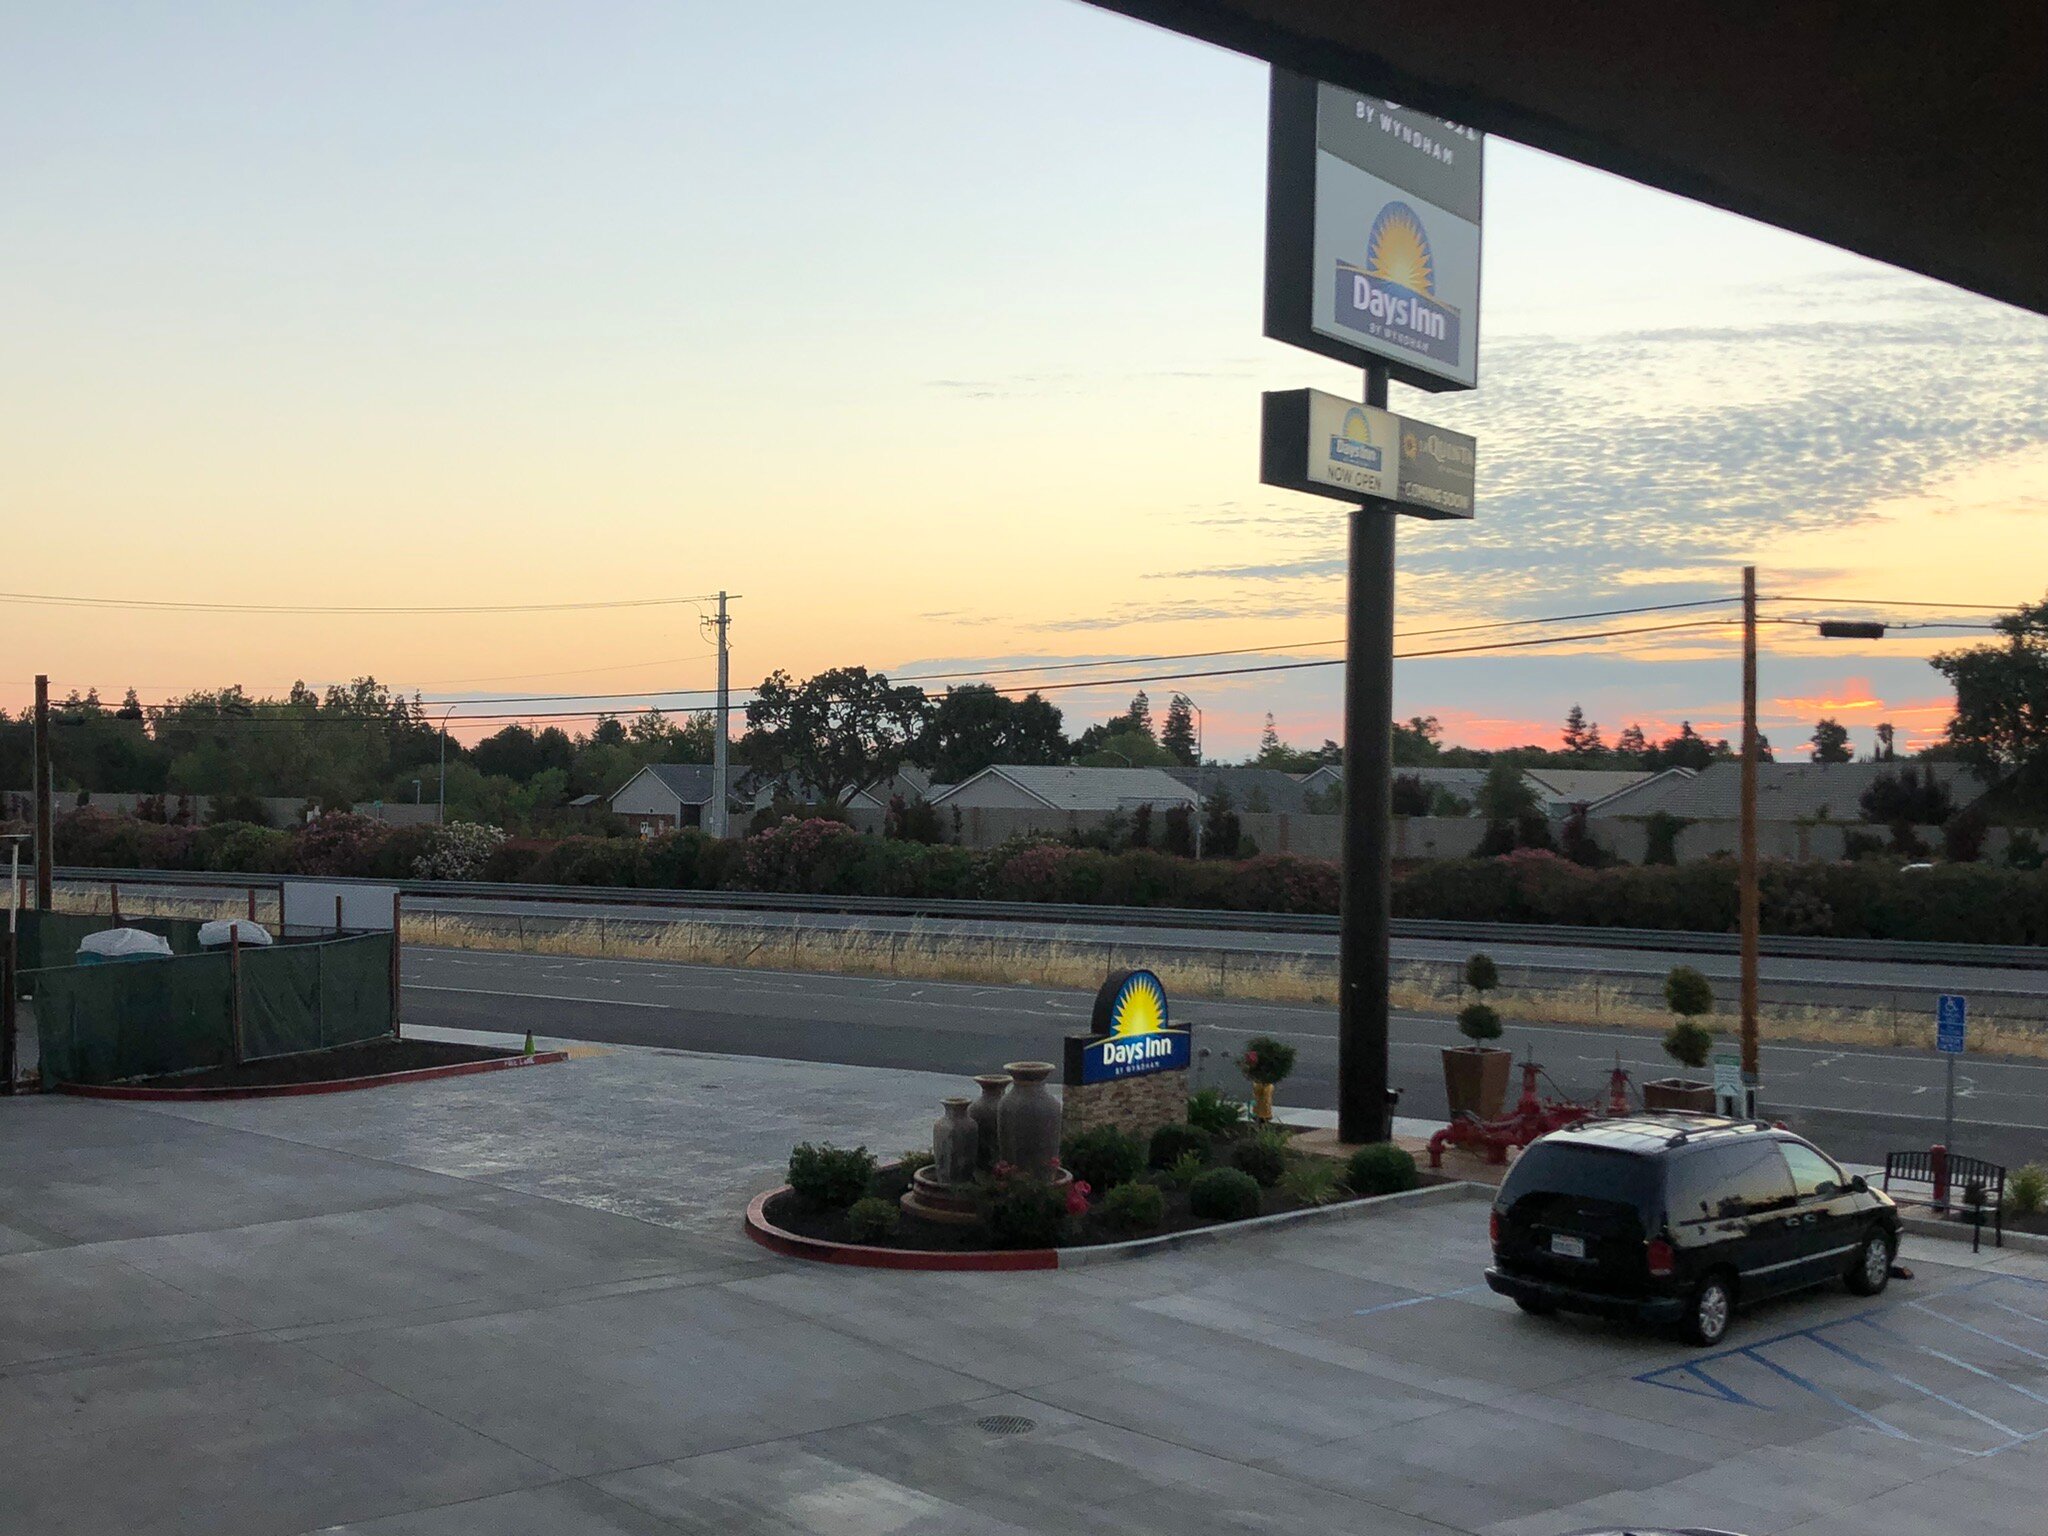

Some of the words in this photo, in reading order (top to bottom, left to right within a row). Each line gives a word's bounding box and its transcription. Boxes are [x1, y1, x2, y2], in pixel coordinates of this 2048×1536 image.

[1356, 100, 1375, 123] BY
[1380, 113, 1453, 165] WYNDHAM
[1353, 274, 1409, 326] Days
[1410, 297, 1445, 341] Inn
[1328, 466, 1352, 483] NOW
[1355, 471, 1381, 490] OPEN
[1103, 1042, 1144, 1065] Days
[1145, 1037, 1172, 1058] Inn
